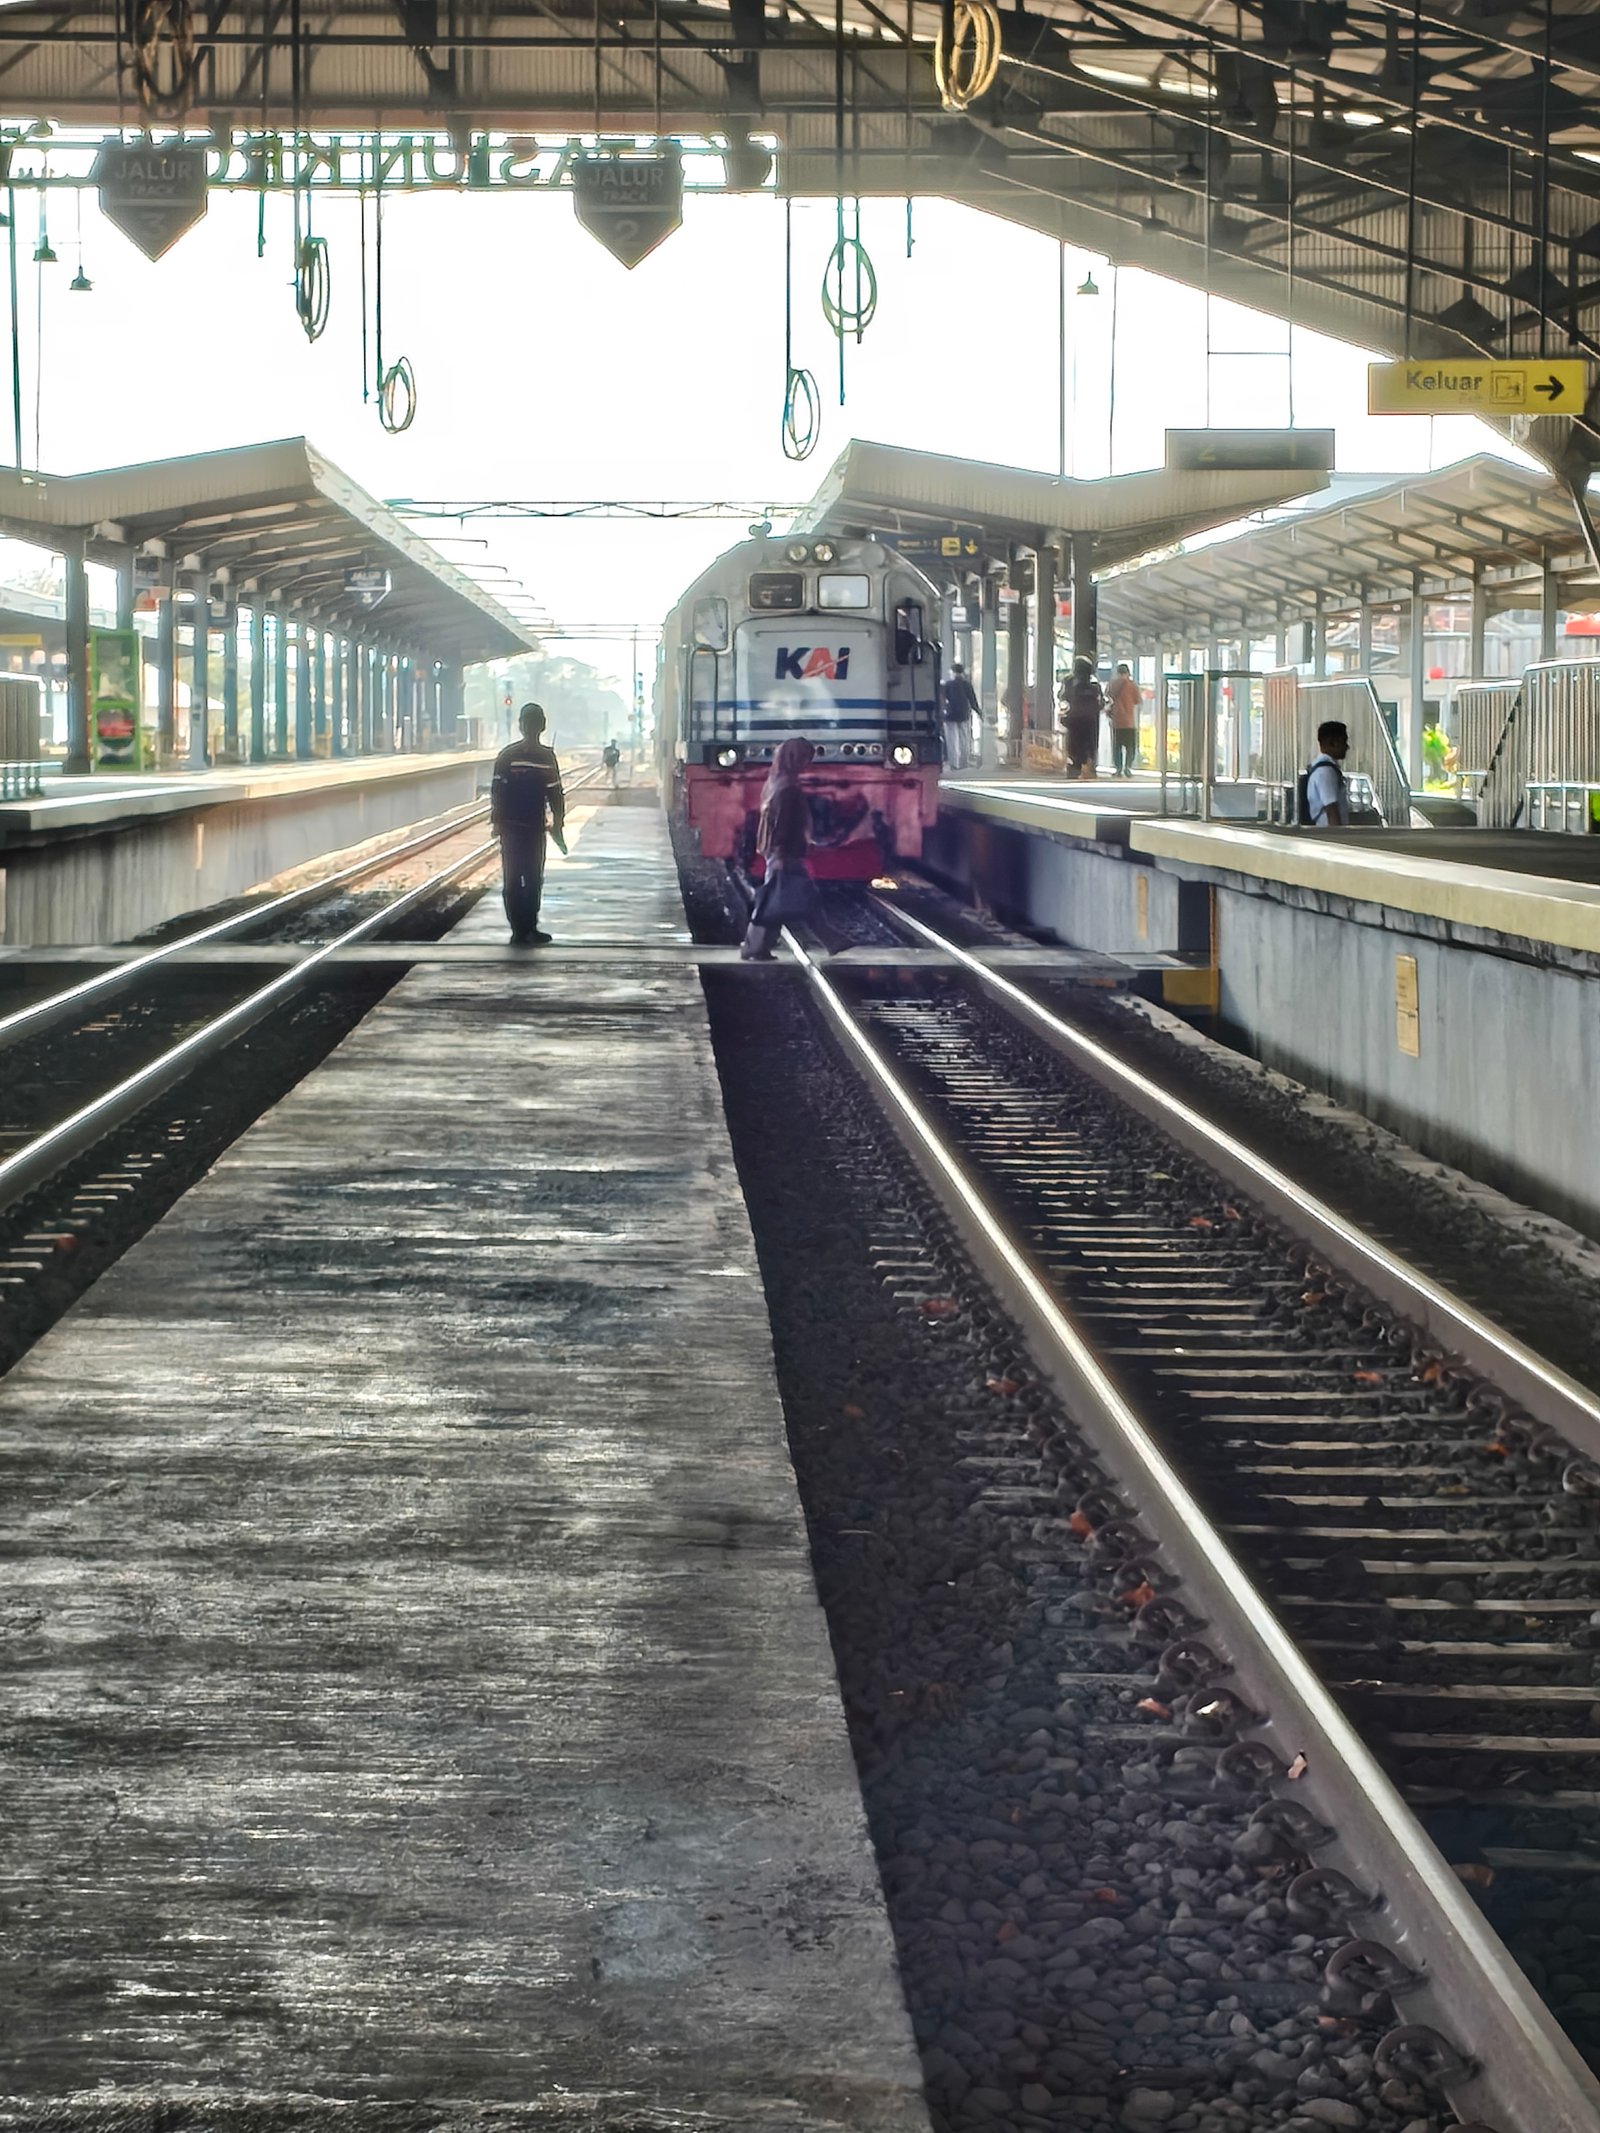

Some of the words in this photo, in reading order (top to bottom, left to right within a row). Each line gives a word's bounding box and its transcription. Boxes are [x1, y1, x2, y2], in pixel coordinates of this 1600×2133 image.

[115, 160, 193, 180] JALUR
[588, 167, 664, 187] JALUR
[615, 219, 642, 247] 2
[1406, 370, 1483, 390] Keluar
[775, 647, 850, 680] KAI
